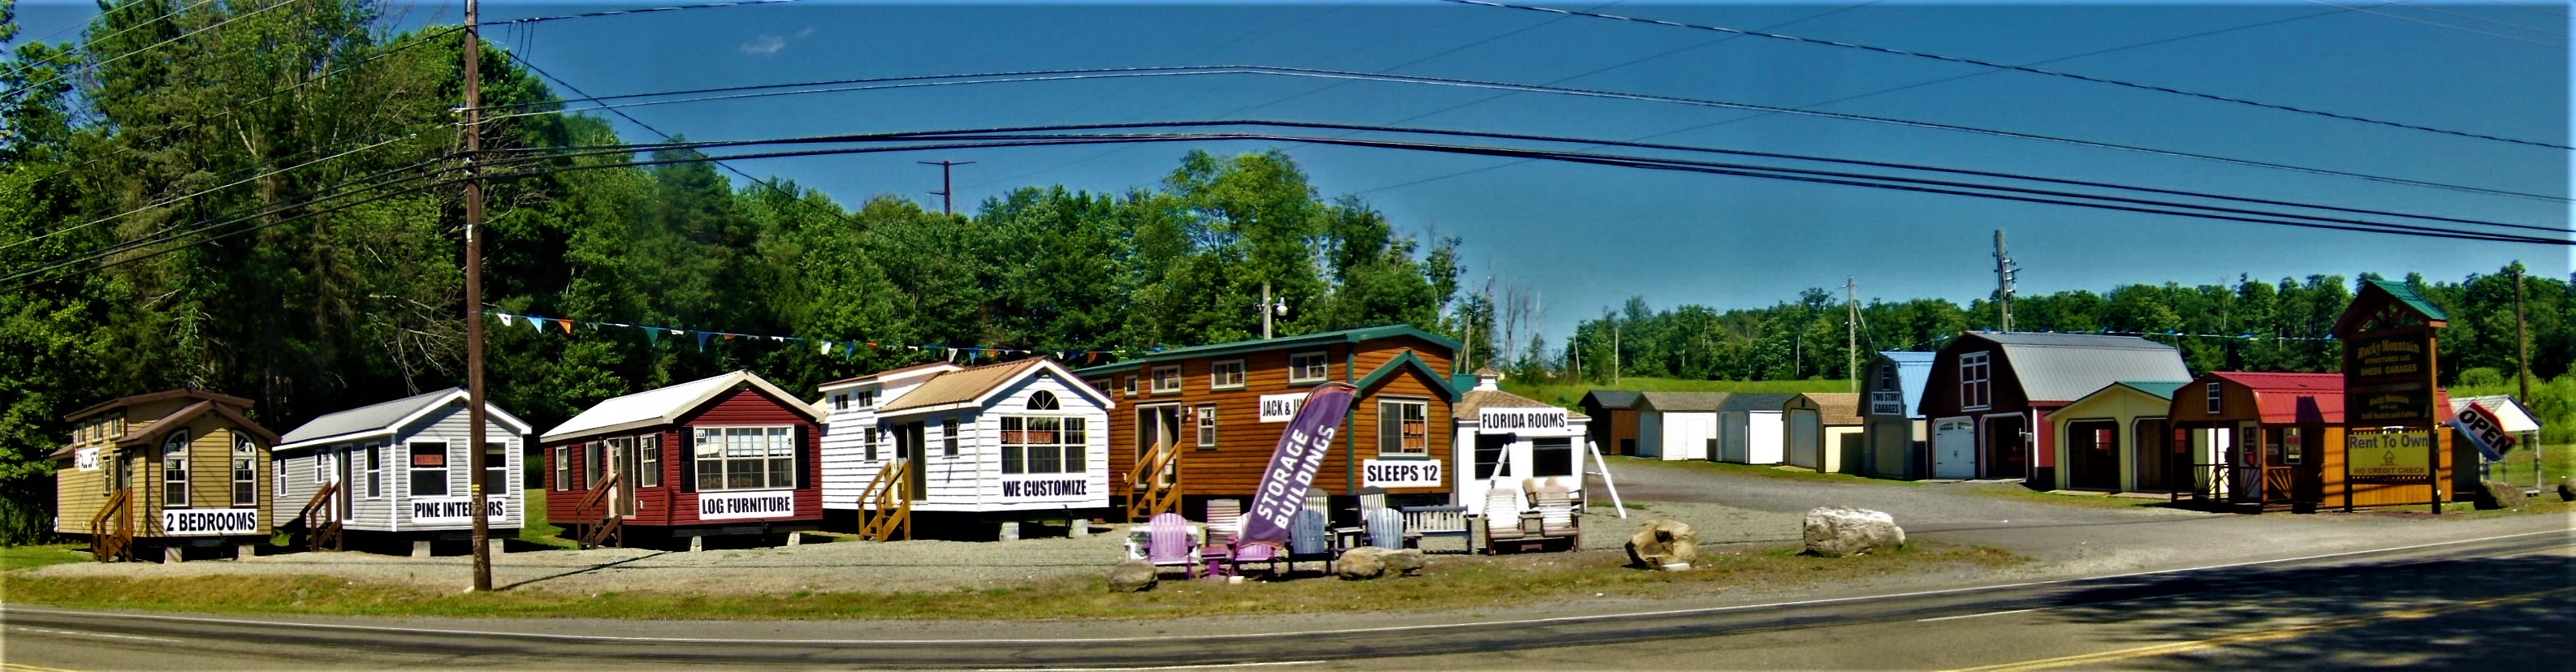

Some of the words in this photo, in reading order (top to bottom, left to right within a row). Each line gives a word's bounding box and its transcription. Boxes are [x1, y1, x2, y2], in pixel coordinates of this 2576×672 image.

[2358, 342, 2380, 359] Rocky
[2382, 339, 2419, 353] Mountain
[2360, 367, 2382, 376] SHEDS
[2385, 364, 2417, 373] GARAGES
[1873, 393, 1883, 401] TWO
[1884, 393, 1900, 401] STORY
[1263, 400, 1283, 416] JACK
[1285, 402, 1290, 416] &
[1874, 404, 1900, 413] GARAGES
[1482, 413, 1525, 429] FLORIDA
[1528, 412, 1565, 428] ROOMS
[2459, 410, 2513, 455] OPEN
[2350, 436, 2378, 449] Rent
[2382, 435, 2397, 449] To
[2401, 434, 2428, 448] Own
[1257, 429, 1309, 520] STORAGE
[1273, 424, 1334, 529] BUILDINGS
[1368, 465, 1419, 481] SLEEPS
[1422, 465, 1437, 481] 12
[1003, 480, 1021, 497] WE
[1023, 480, 1087, 497] CUSTOMIZE
[414, 502, 440, 518] PINE
[443, 501, 503, 517] INTERS
[702, 498, 724, 515] LOG
[728, 497, 790, 513] FURNITURE
[166, 513, 174, 532] 2
[179, 512, 256, 532] BEDROOMS
